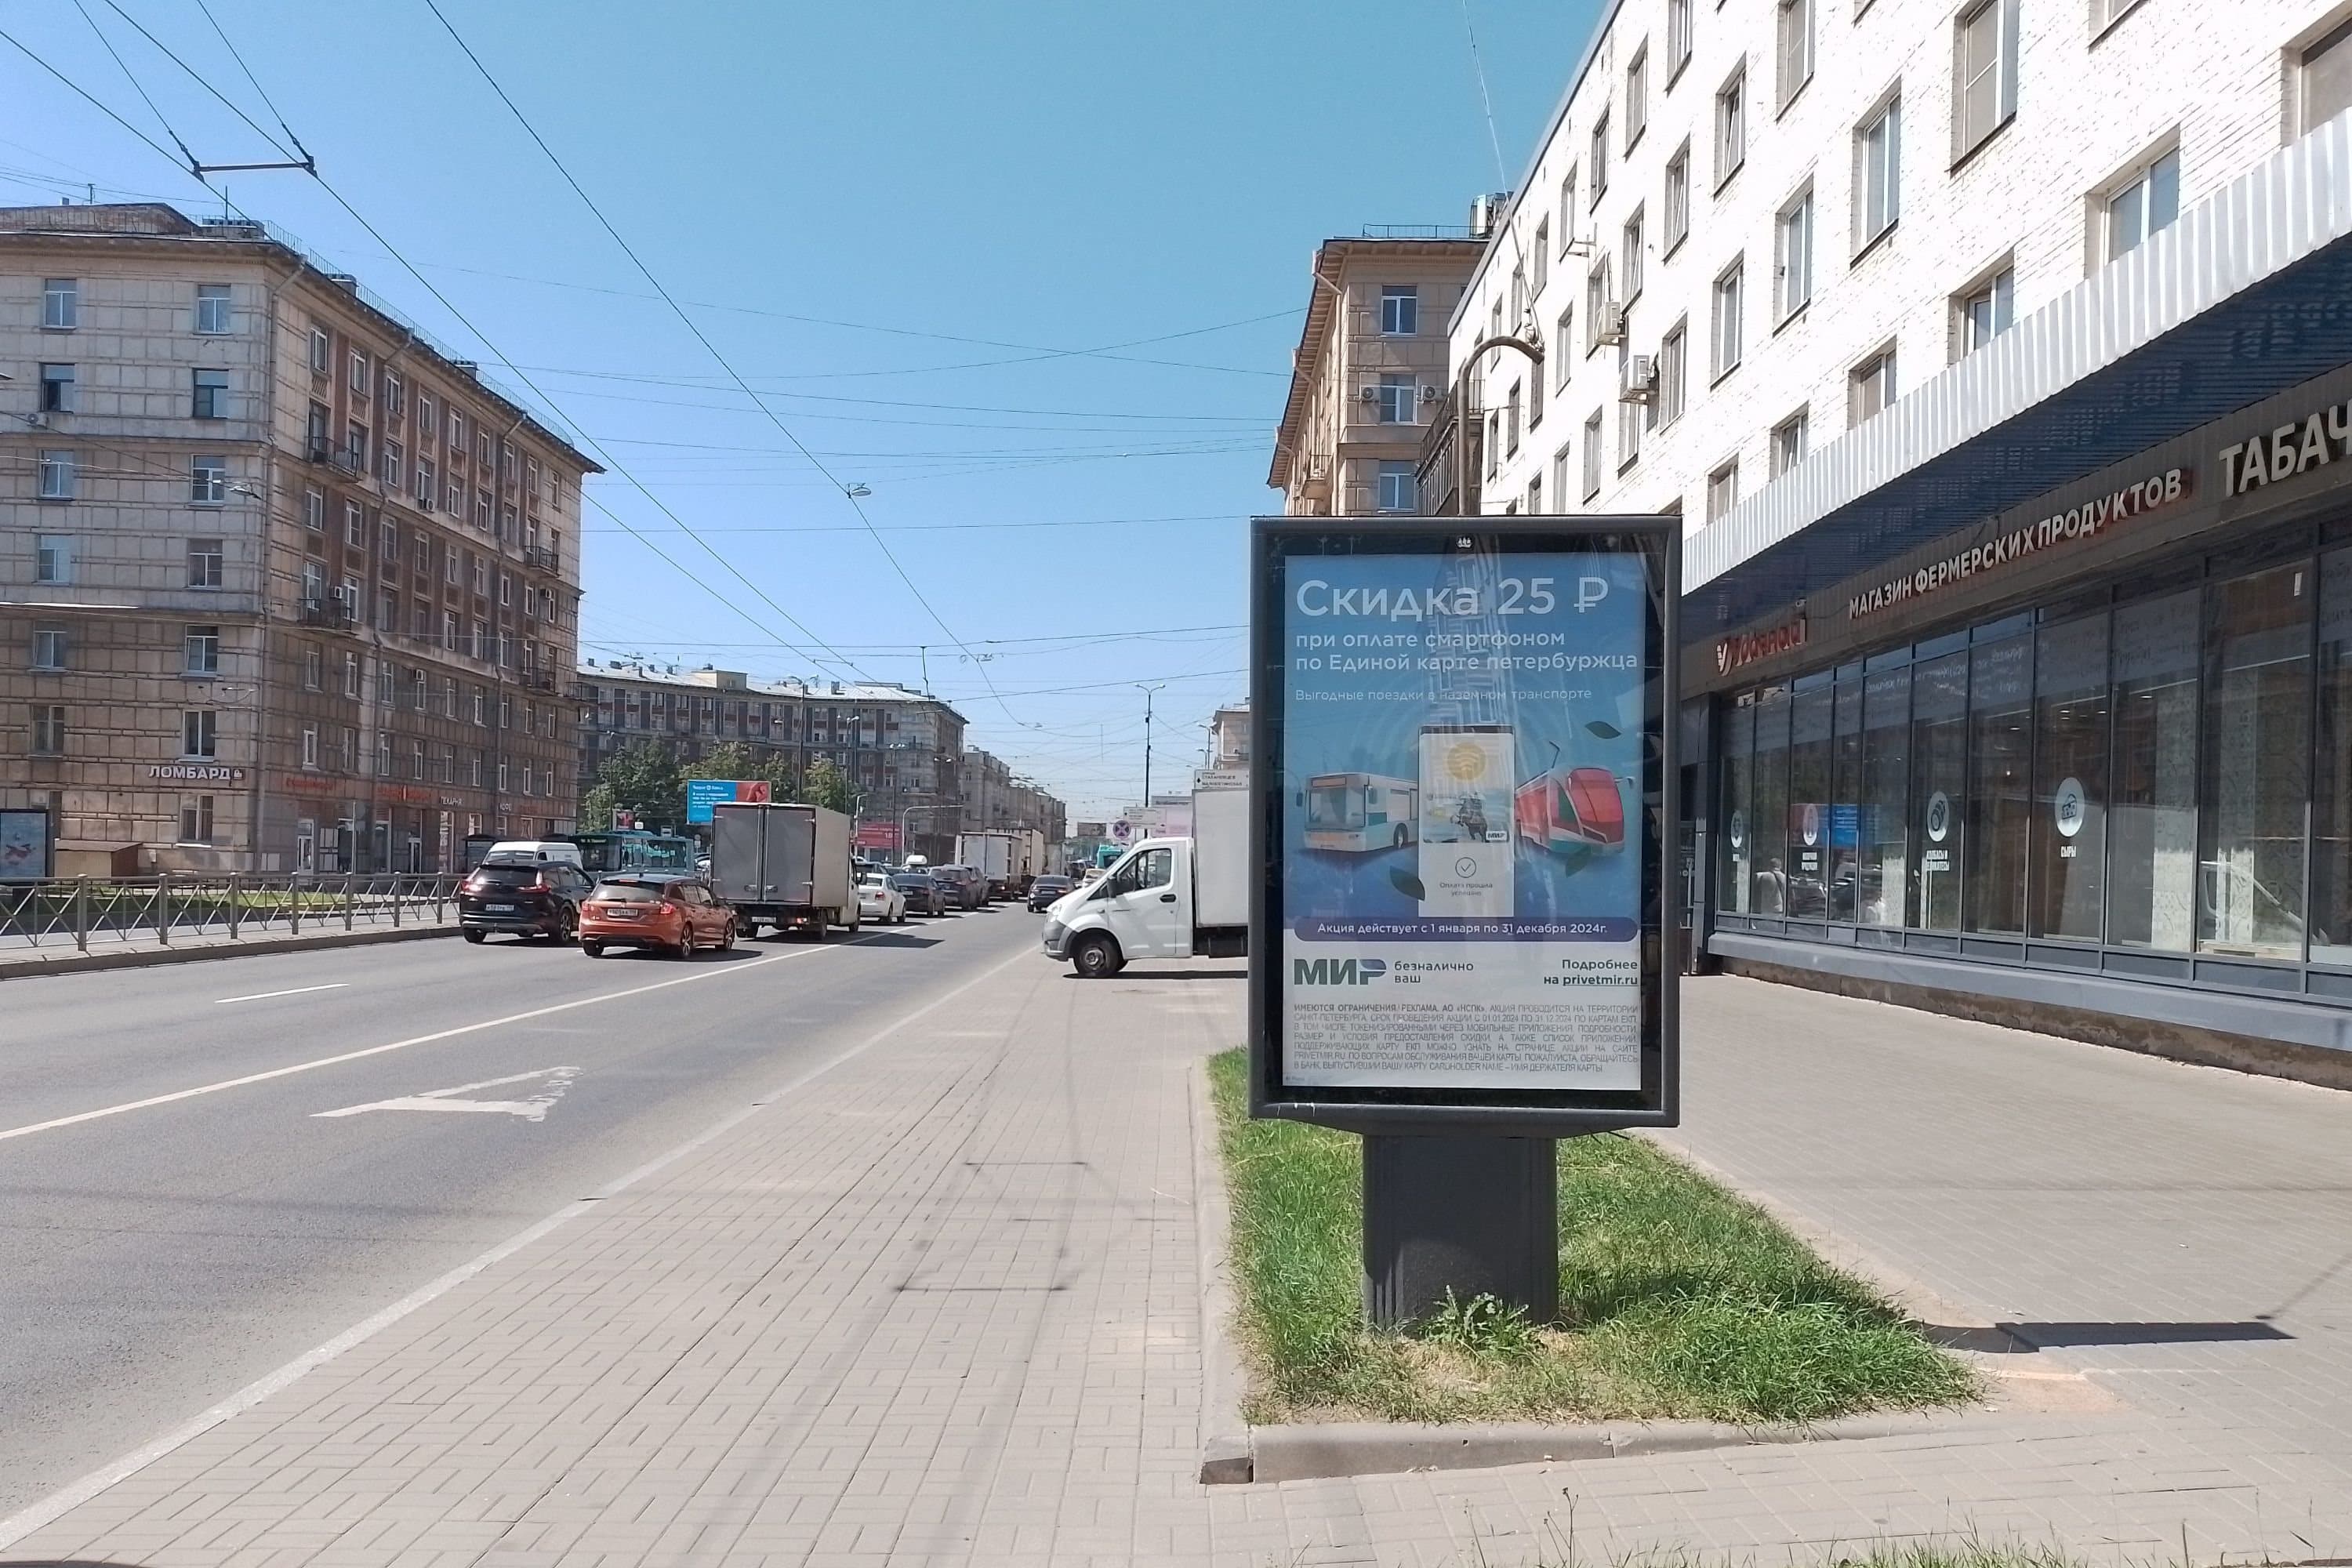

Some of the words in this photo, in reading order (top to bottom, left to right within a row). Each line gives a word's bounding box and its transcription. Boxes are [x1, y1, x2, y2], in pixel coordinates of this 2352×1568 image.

[1849, 576, 1911, 619] МАГАЗИН
[1915, 525, 2038, 594] ФЕРМЕРСКИХ
[2038, 469, 2181, 548] ПРОДУКТОВ
[1297, 579, 1479, 622] Скидка
[1498, 578, 1555, 615] 25
[1296, 633, 1335, 650] при
[1343, 633, 1417, 648] оплате
[1425, 630, 1565, 651] смартфоном
[1296, 657, 1322, 670] по
[1330, 653, 1410, 673] Единой
[1417, 656, 1479, 673] карте
[1487, 652, 1638, 672] петербуржца
[1296, 689, 1364, 702] Выгодные
[1368, 690, 1424, 702] поездки
[1428, 691, 1436, 701] в
[1440, 690, 1506, 701] наземном
[1512, 688, 1592, 701] транспорте
[149, 766, 231, 780] ЛОМБАРД
[1318, 923, 1355, 935] Акция
[1358, 923, 1417, 935] действует
[1421, 924, 1428, 933] с
[1430, 923, 1436, 933] 1
[1439, 924, 1480, 935] января
[1484, 924, 1498, 933] по
[1502, 924, 1514, 935] 31
[1516, 924, 1566, 935] декабря
[1570, 924, 1608, 934] 2024г.
[1294, 959, 1387, 985] МИР
[1395, 961, 1474, 971] безналично
[1562, 959, 1638, 971] Подробнее
[1395, 975, 1421, 984] ваш
[1544, 976, 1559, 985] на
[1563, 975, 1638, 986] privetmir.ru
